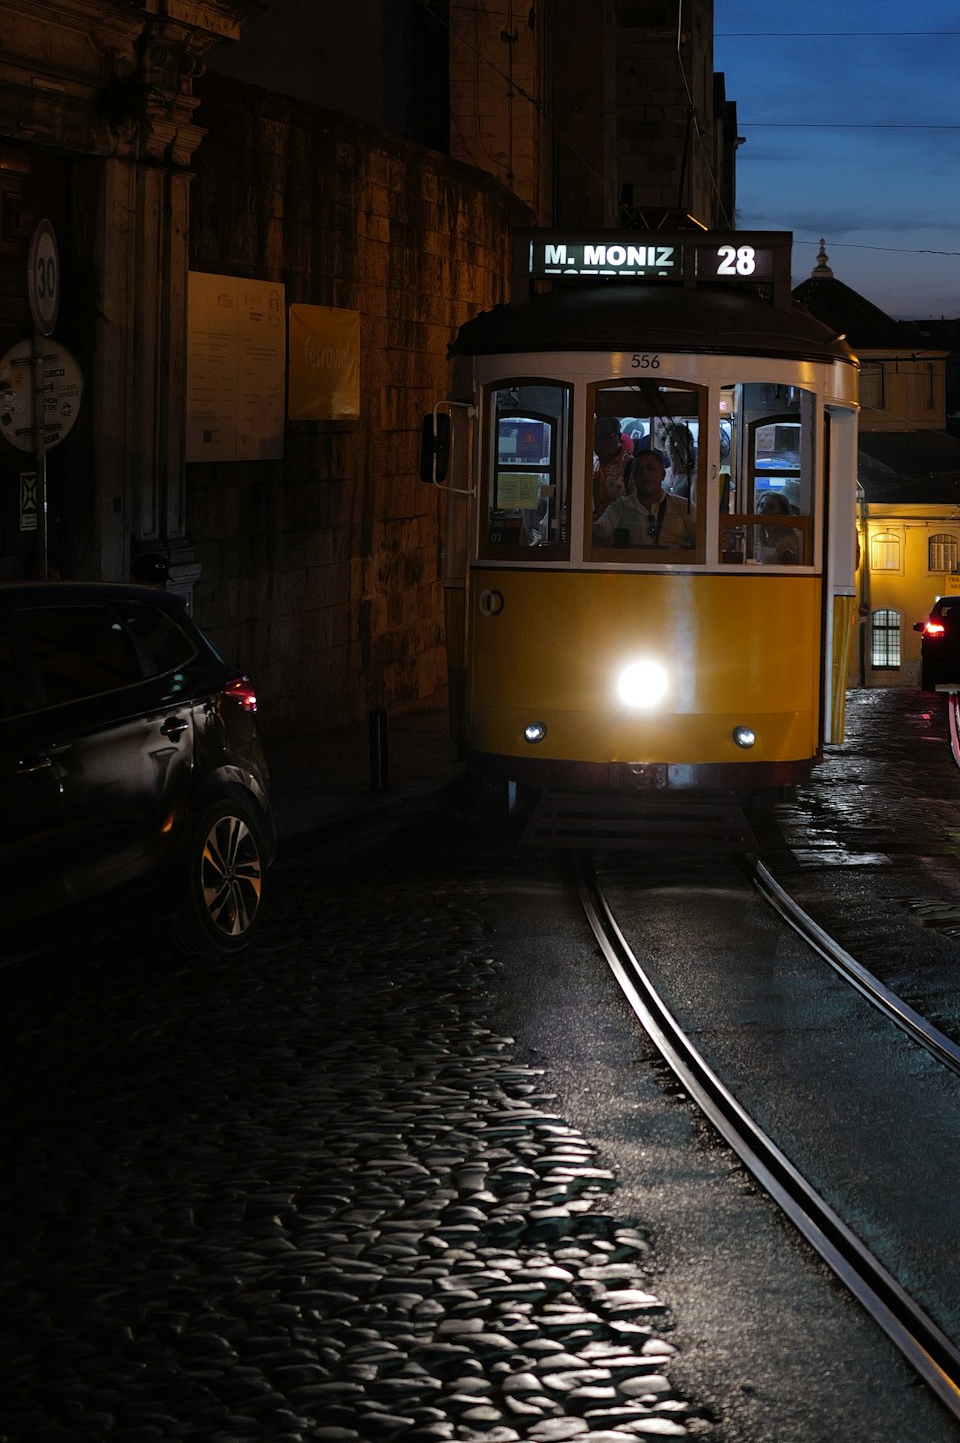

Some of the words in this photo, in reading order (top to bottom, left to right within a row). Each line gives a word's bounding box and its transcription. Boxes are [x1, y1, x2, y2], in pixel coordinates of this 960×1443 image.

[545, 245, 575, 265] M.
[584, 245, 674, 266] MONIZ
[717, 245, 756, 276] 28
[38, 257, 56, 299] 30
[631, 354, 660, 369] 556
